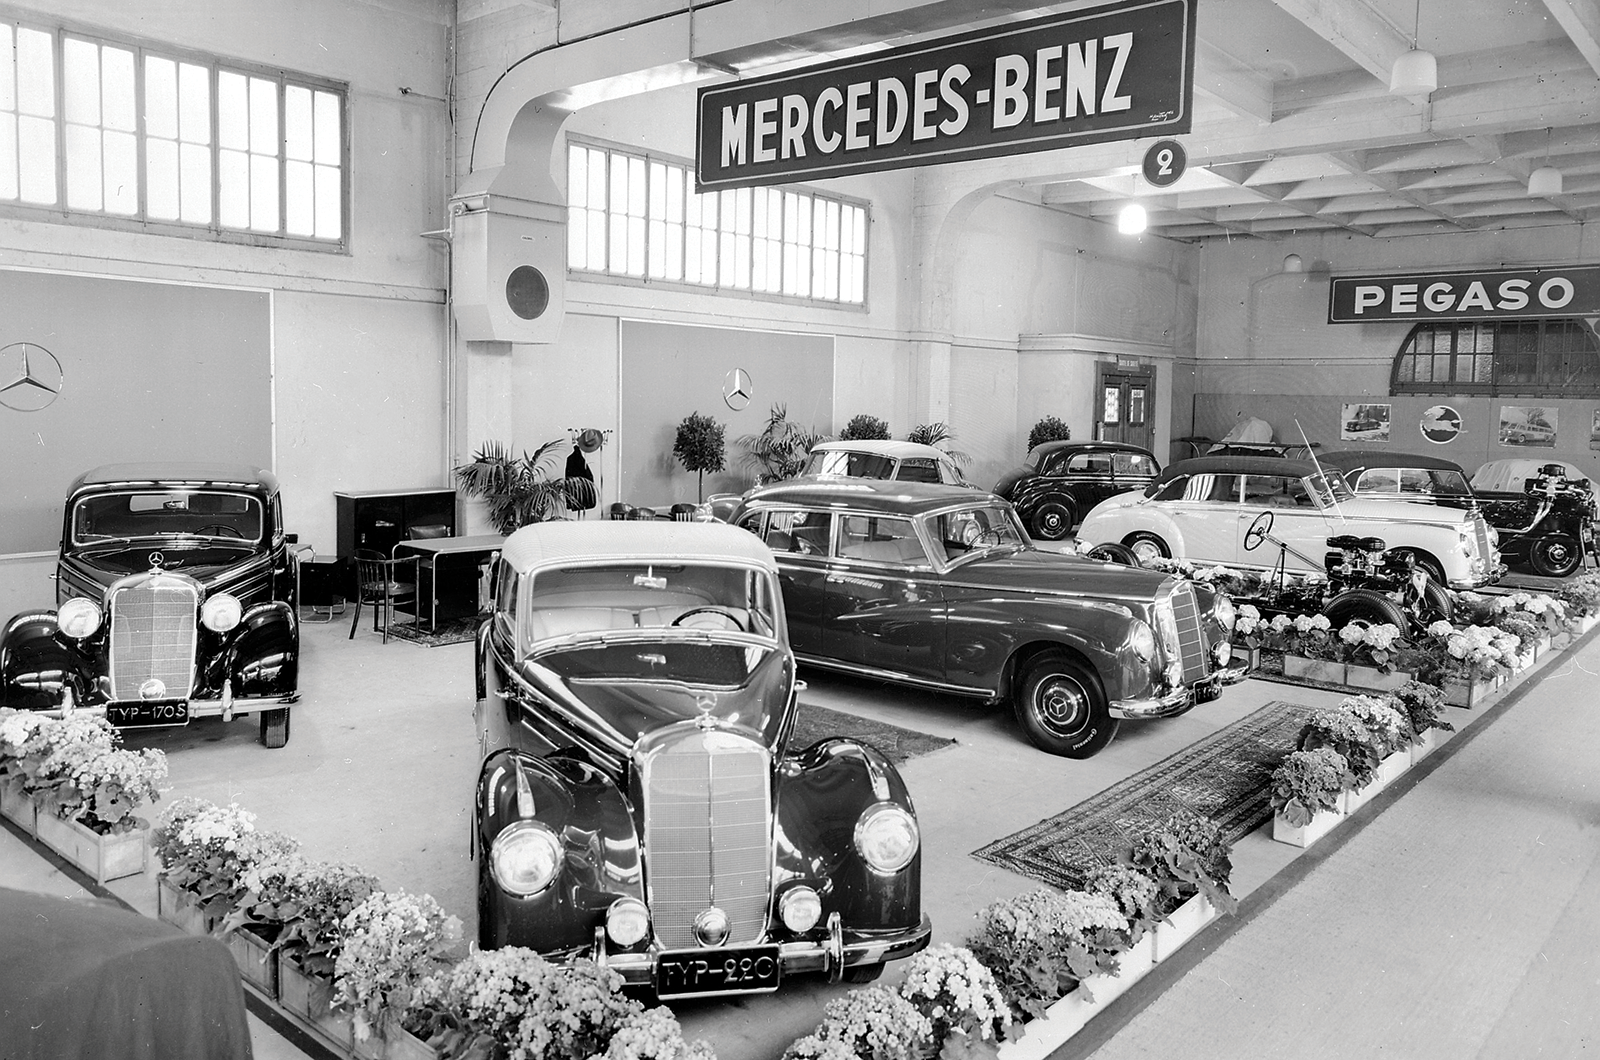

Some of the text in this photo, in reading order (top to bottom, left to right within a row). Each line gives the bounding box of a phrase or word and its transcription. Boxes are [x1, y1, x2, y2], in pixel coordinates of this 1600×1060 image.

[720, 32, 1133, 168] MERCEDES-BENZ
[1157, 148, 1173, 175] 2
[1354, 277, 1574, 314] PEGASO
[662, 956, 774, 986] TYP-220
